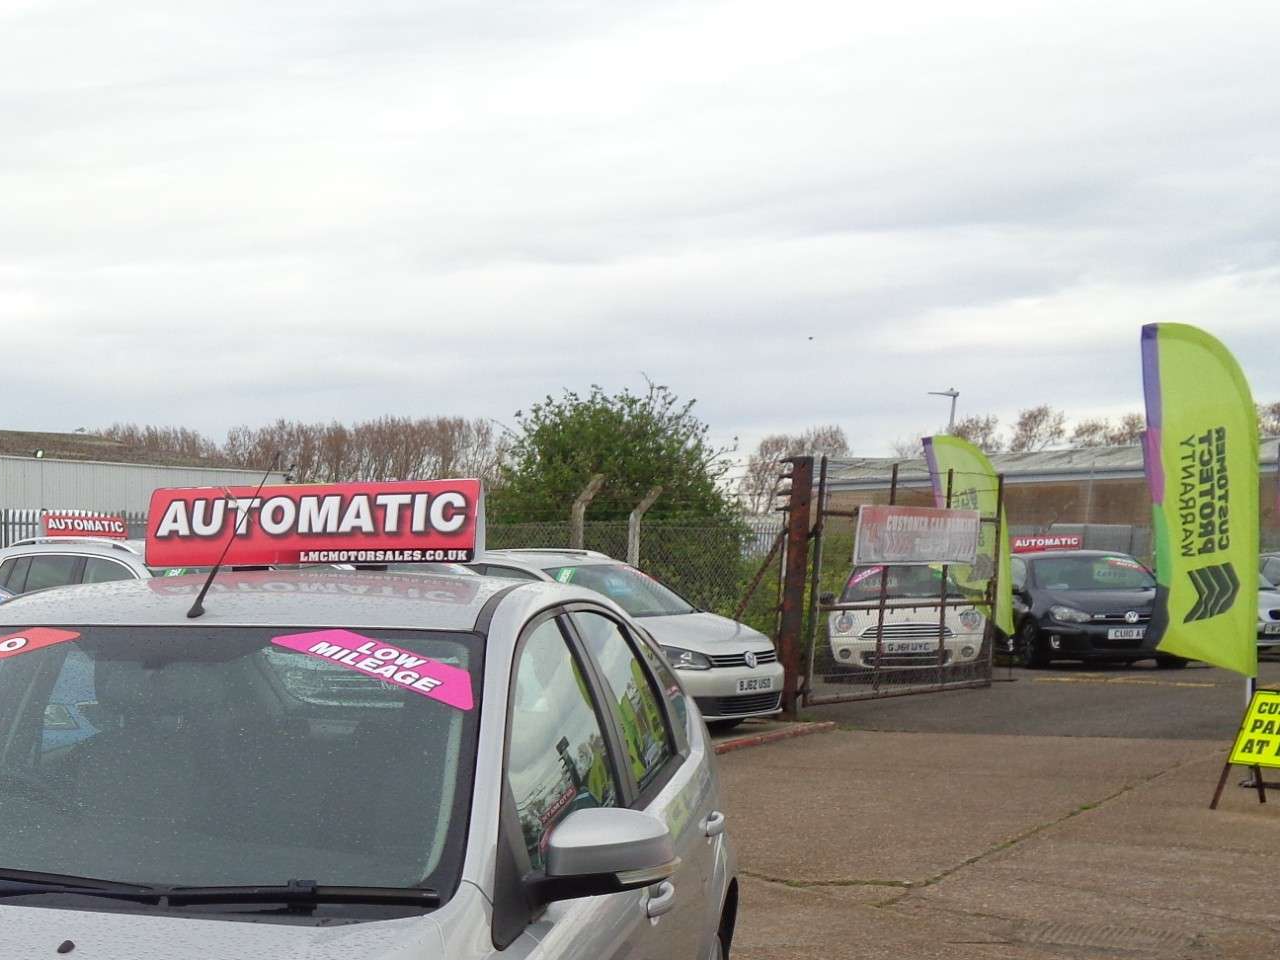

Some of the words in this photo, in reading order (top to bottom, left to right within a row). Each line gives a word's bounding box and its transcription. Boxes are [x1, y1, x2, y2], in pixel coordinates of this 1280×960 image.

[157, 492, 468, 538] AUTOMATIC
[48, 518, 124, 533] AUTOMATIC
[1015, 537, 1079, 547] AUTOMATIC
[299, 550, 468, 562] LMCMOTORSALES.CO.UK
[356, 641, 427, 669] LOW
[308, 641, 442, 692] MILEAGE
[1258, 702, 1280, 715] CU
[1241, 738, 1270, 754] AT
